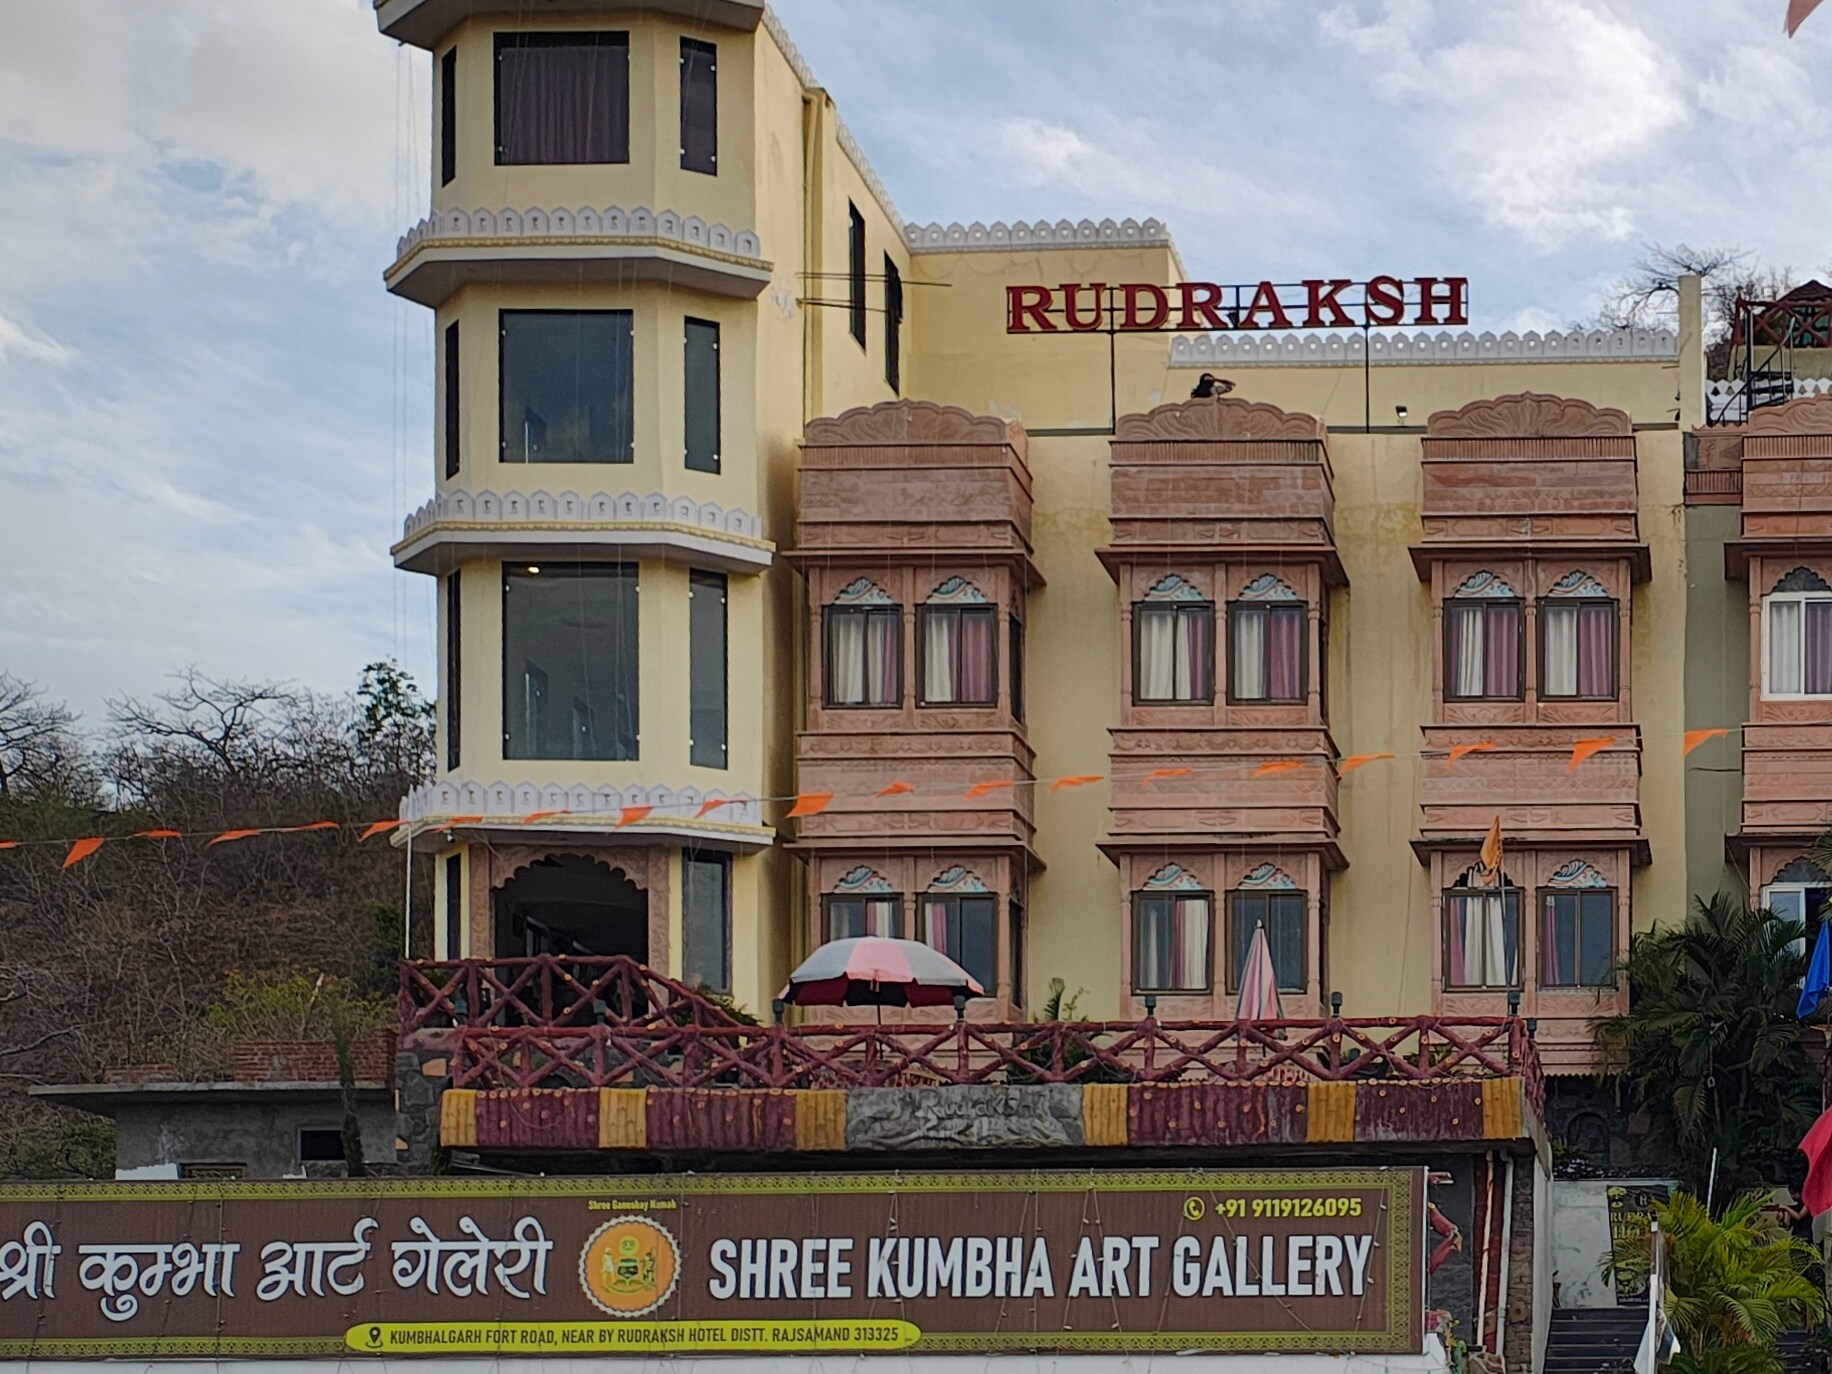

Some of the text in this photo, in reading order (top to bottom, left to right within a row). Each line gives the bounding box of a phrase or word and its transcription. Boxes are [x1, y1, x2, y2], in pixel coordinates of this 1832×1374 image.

[1006, 276, 1468, 333] RUDRAKSH
[1215, 1198, 1362, 1218] +91 9119126095
[0, 1216, 554, 1322] श्री कुम्भा आर्ट गेलेरी
[709, 1234, 1373, 1299] SHREE KUMBHA ART GALLERY
[390, 1327, 899, 1346] KUMBHALGARH FORT ROAD, NEAR BY RUDRAKSH HOTEL DISTT. RAJSAMAND 313325
